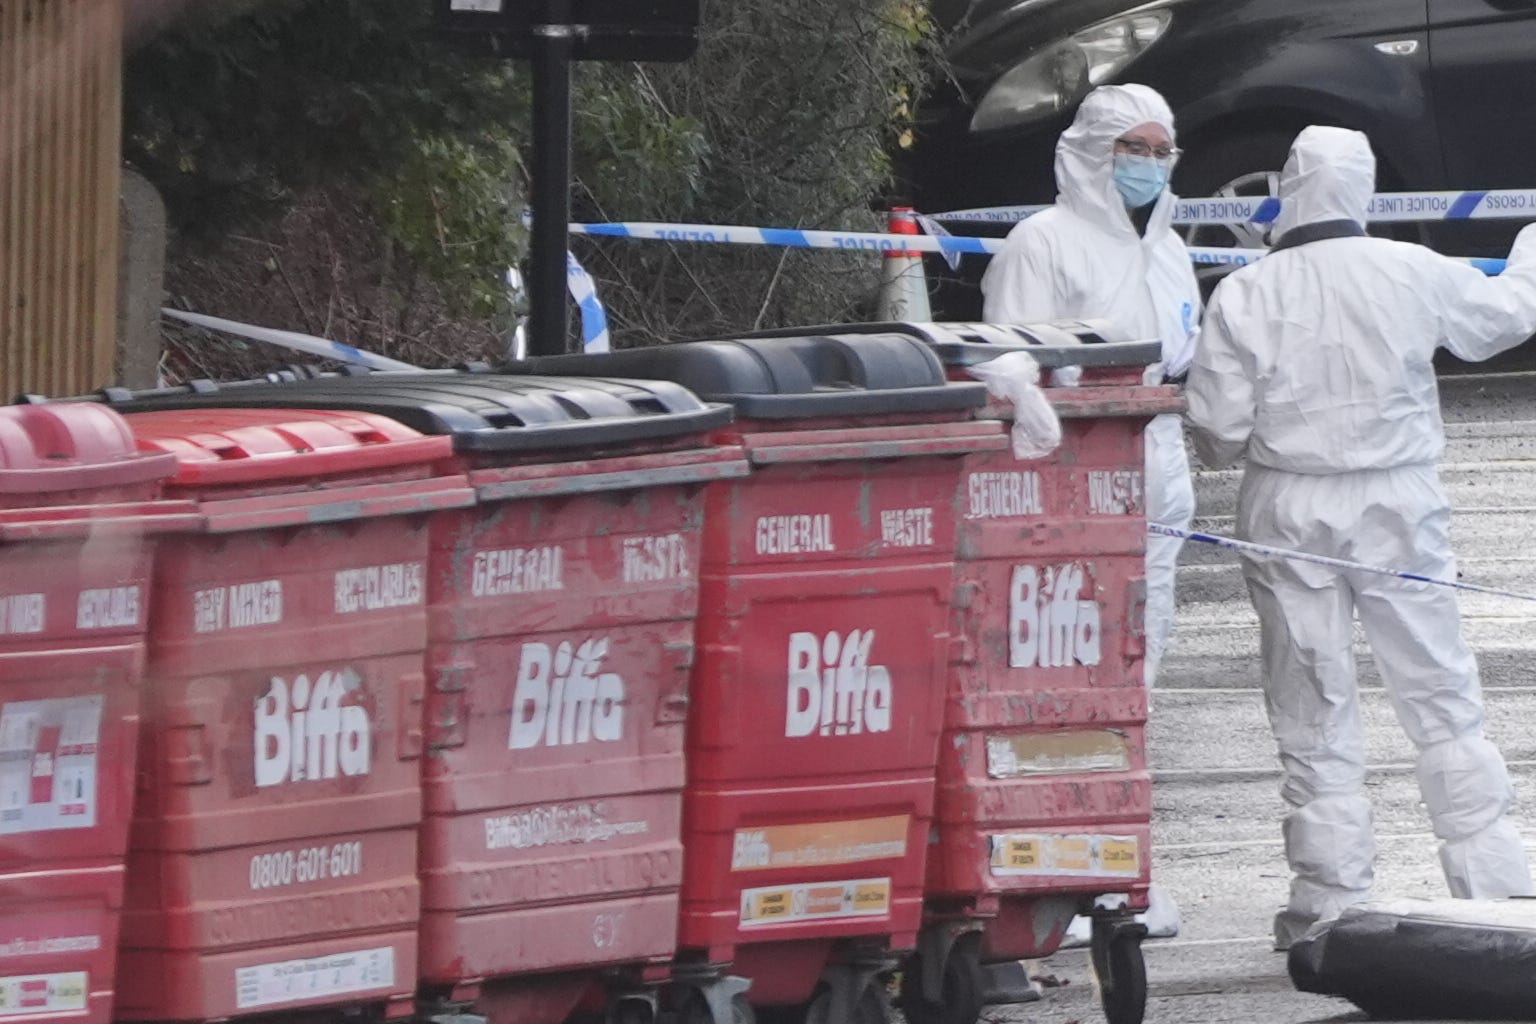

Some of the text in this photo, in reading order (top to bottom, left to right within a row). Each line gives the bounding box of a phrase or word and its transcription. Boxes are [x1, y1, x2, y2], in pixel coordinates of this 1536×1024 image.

[1181, 202, 1206, 219] LINE
[1210, 202, 1251, 219] POLICE
[1377, 198, 1403, 213] LINE
[1407, 196, 1448, 213] POLICE
[1486, 195, 1526, 209] CROSS
[967, 470, 1043, 516] GENERAL
[755, 507, 935, 555] GENERAL WASTE
[472, 545, 564, 597] GENERAL
[1009, 561, 1101, 668] Biffa
[508, 636, 625, 750] Biffa
[785, 628, 893, 738] Biffa
[254, 670, 370, 787] Biffa
